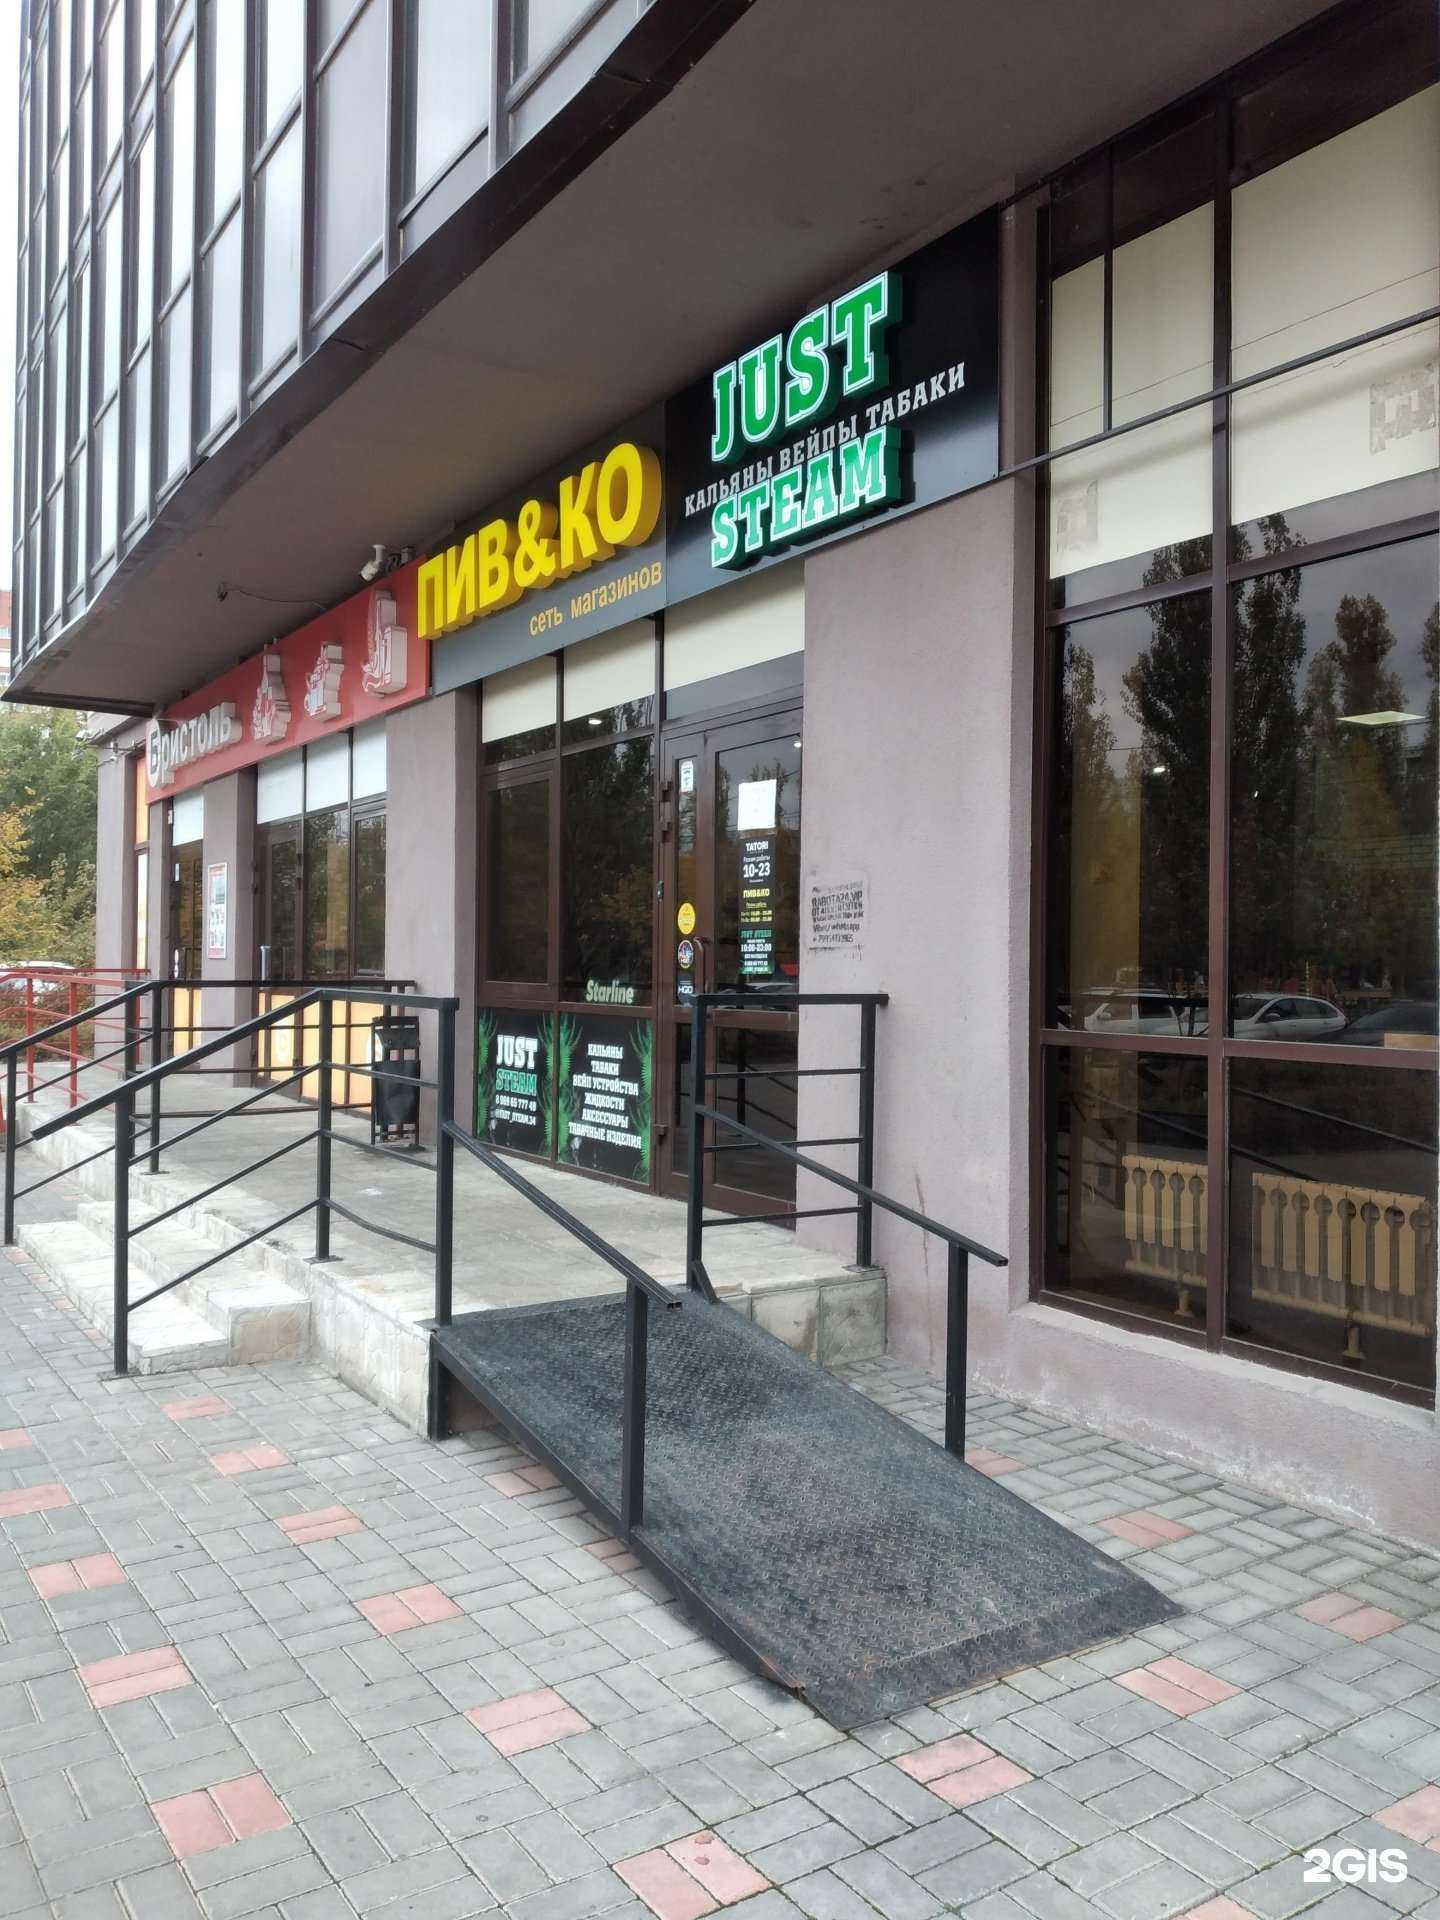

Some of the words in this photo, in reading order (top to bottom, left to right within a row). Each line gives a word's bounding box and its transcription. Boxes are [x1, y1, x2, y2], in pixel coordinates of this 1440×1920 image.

[711, 271, 888, 462] JUST
[685, 456, 773, 517] КАЛЬЯНЫ
[779, 413, 858, 472] ВЕЙПЫ
[865, 361, 965, 430] ТАБАКИ
[711, 425, 887, 568] STEAM
[418, 442, 652, 640] ПИВ&КО
[529, 606, 563, 636] сеть
[570, 561, 662, 620] магазинов
[743, 862, 770, 878] 10-23
[586, 979, 634, 1004] Starline
[496, 1034, 538, 1069] JUST
[587, 1043, 623, 1060] КАЛЬЯНЫ
[591, 1060, 620, 1076] ТАБАКИ
[495, 1068, 537, 1097] STEAM
[572, 1073, 592, 1088] ВЕЙП
[592, 1077, 639, 1096] УСТРОЙСТВА
[518, 1098, 529, 1110] 777
[584, 1092, 625, 1111] ЖИДКОСТИ
[582, 1108, 629, 1129] АКСЕССУАРЫ
[568, 1121, 606, 1141] ТАБАЧНЫЕ
[606, 1129, 642, 1149] ИЗДЕЛИЯ
